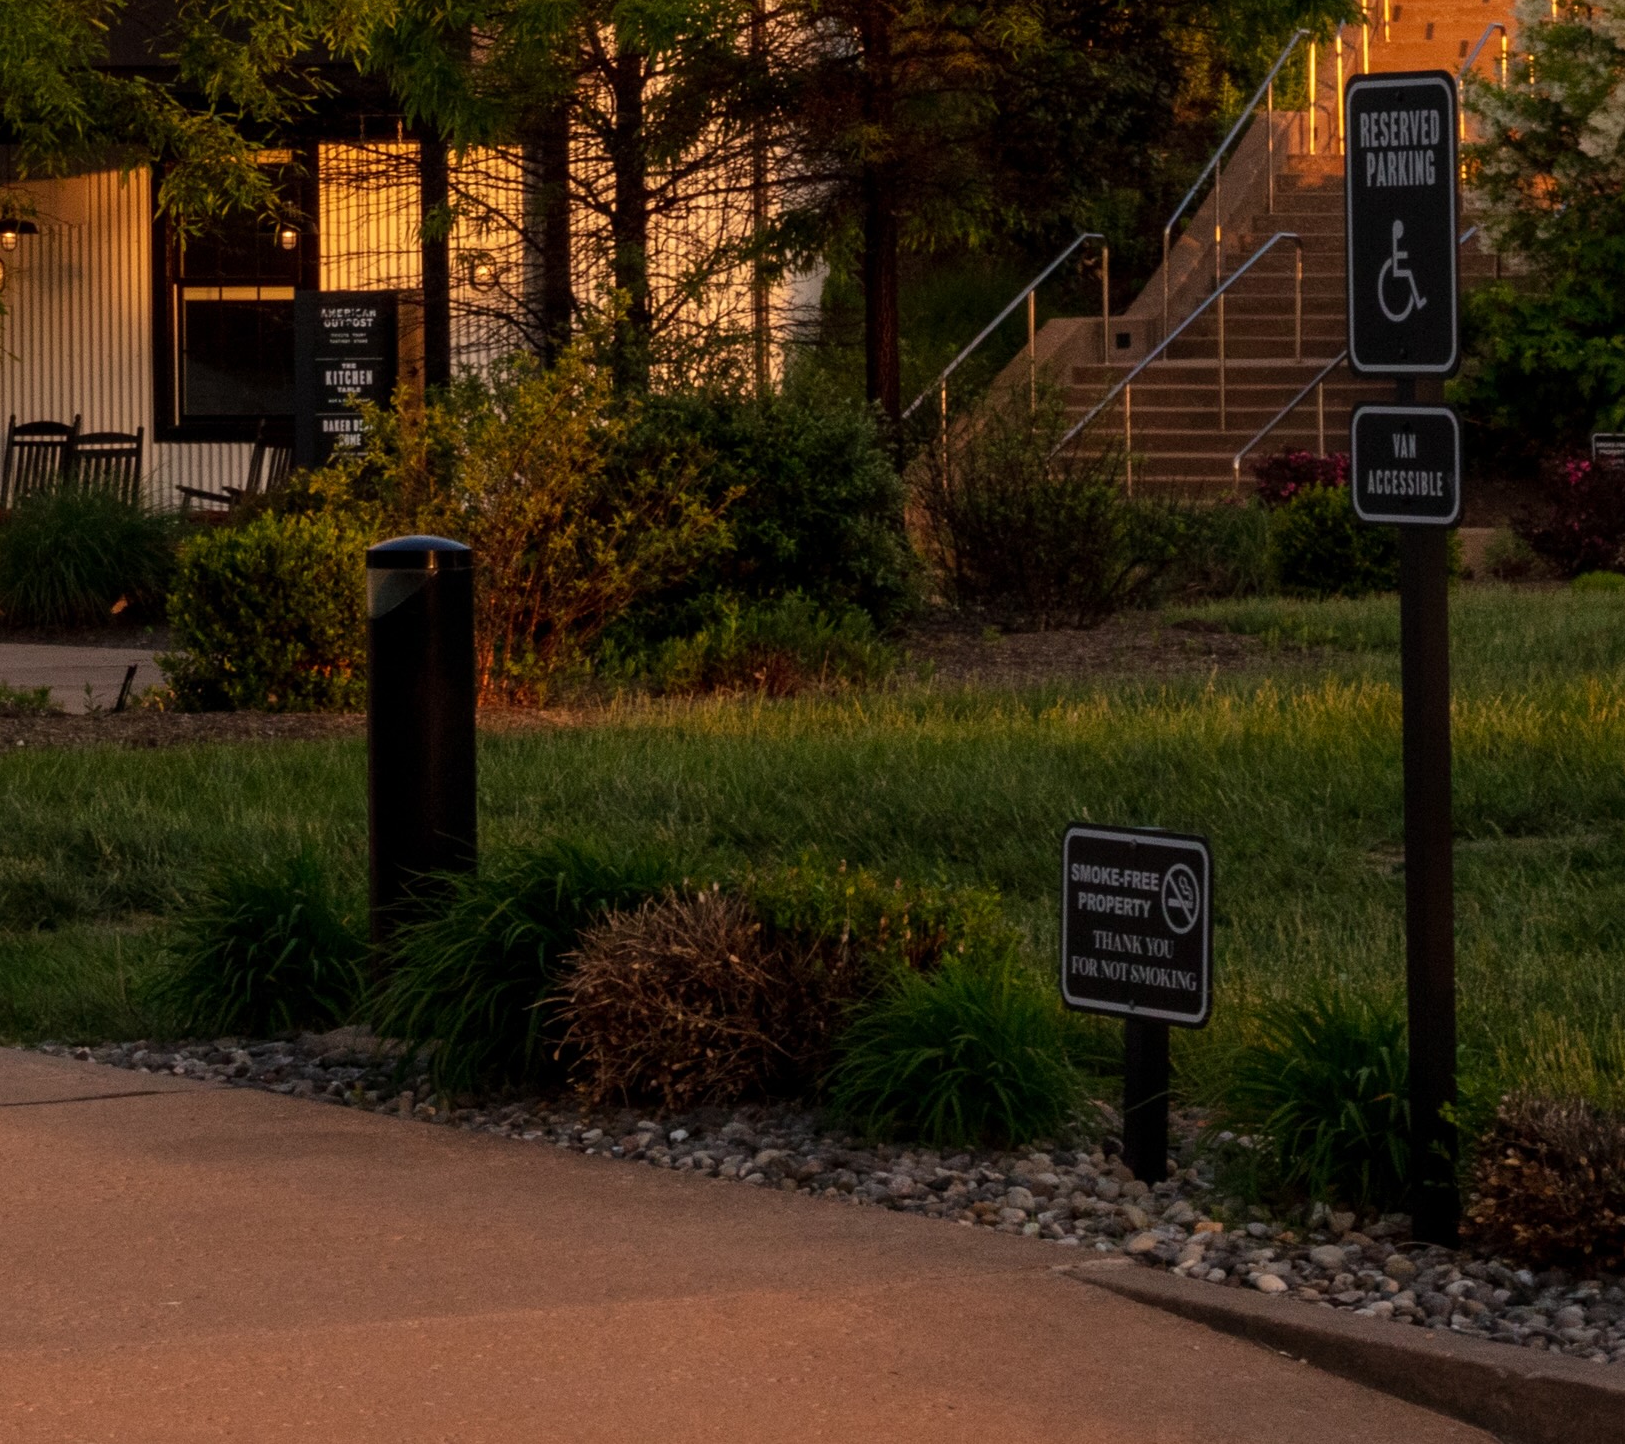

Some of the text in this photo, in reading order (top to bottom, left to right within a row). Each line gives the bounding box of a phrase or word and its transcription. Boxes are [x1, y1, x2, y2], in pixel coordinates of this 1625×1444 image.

[1359, 109, 1439, 147] RESERVED
[1365, 149, 1435, 186] PARKING
[320, 307, 376, 318] AMERICAN
[325, 369, 372, 386] KITCHEN
[322, 419, 351, 433] BAKER
[1392, 432, 1417, 458] VAN
[1366, 469, 1443, 495] ACCESSIBLE
[1071, 863, 1160, 891] SMOKE-FREE
[1078, 892, 1151, 917] PROPERTY
[1093, 930, 1174, 957] THANK YOU
[1071, 956, 1197, 990] FOR NOT SMOKING
